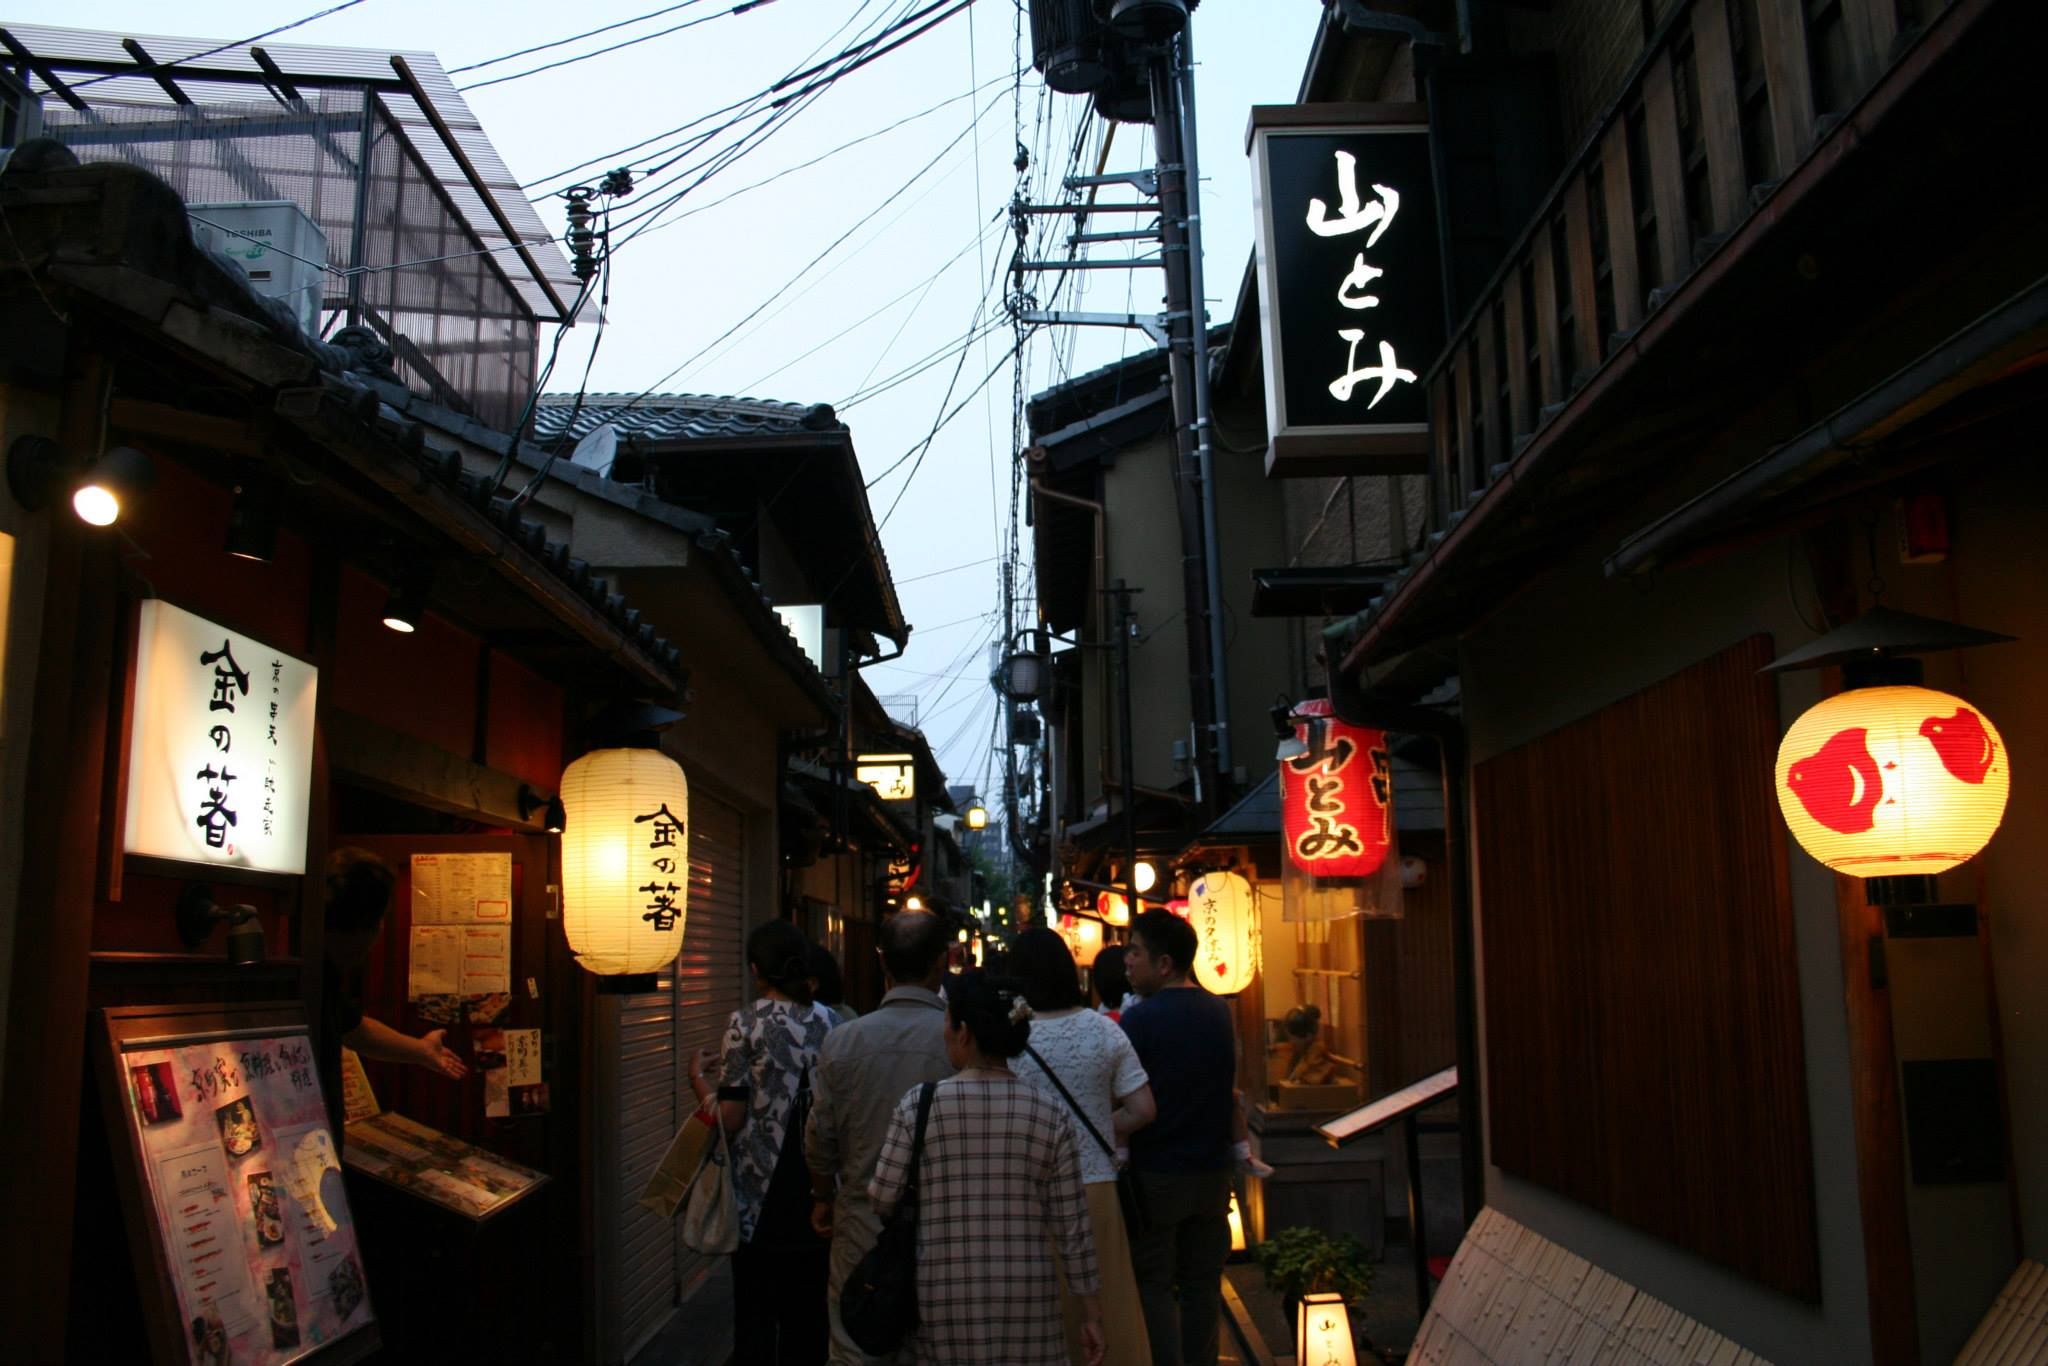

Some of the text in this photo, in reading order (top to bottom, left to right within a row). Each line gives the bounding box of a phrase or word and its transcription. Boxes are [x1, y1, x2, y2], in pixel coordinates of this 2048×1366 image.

[226, 228, 272, 239] TOSHIBA
[1306, 150, 1418, 410] 山とみ
[1289, 719, 1364, 861] 山とみ
